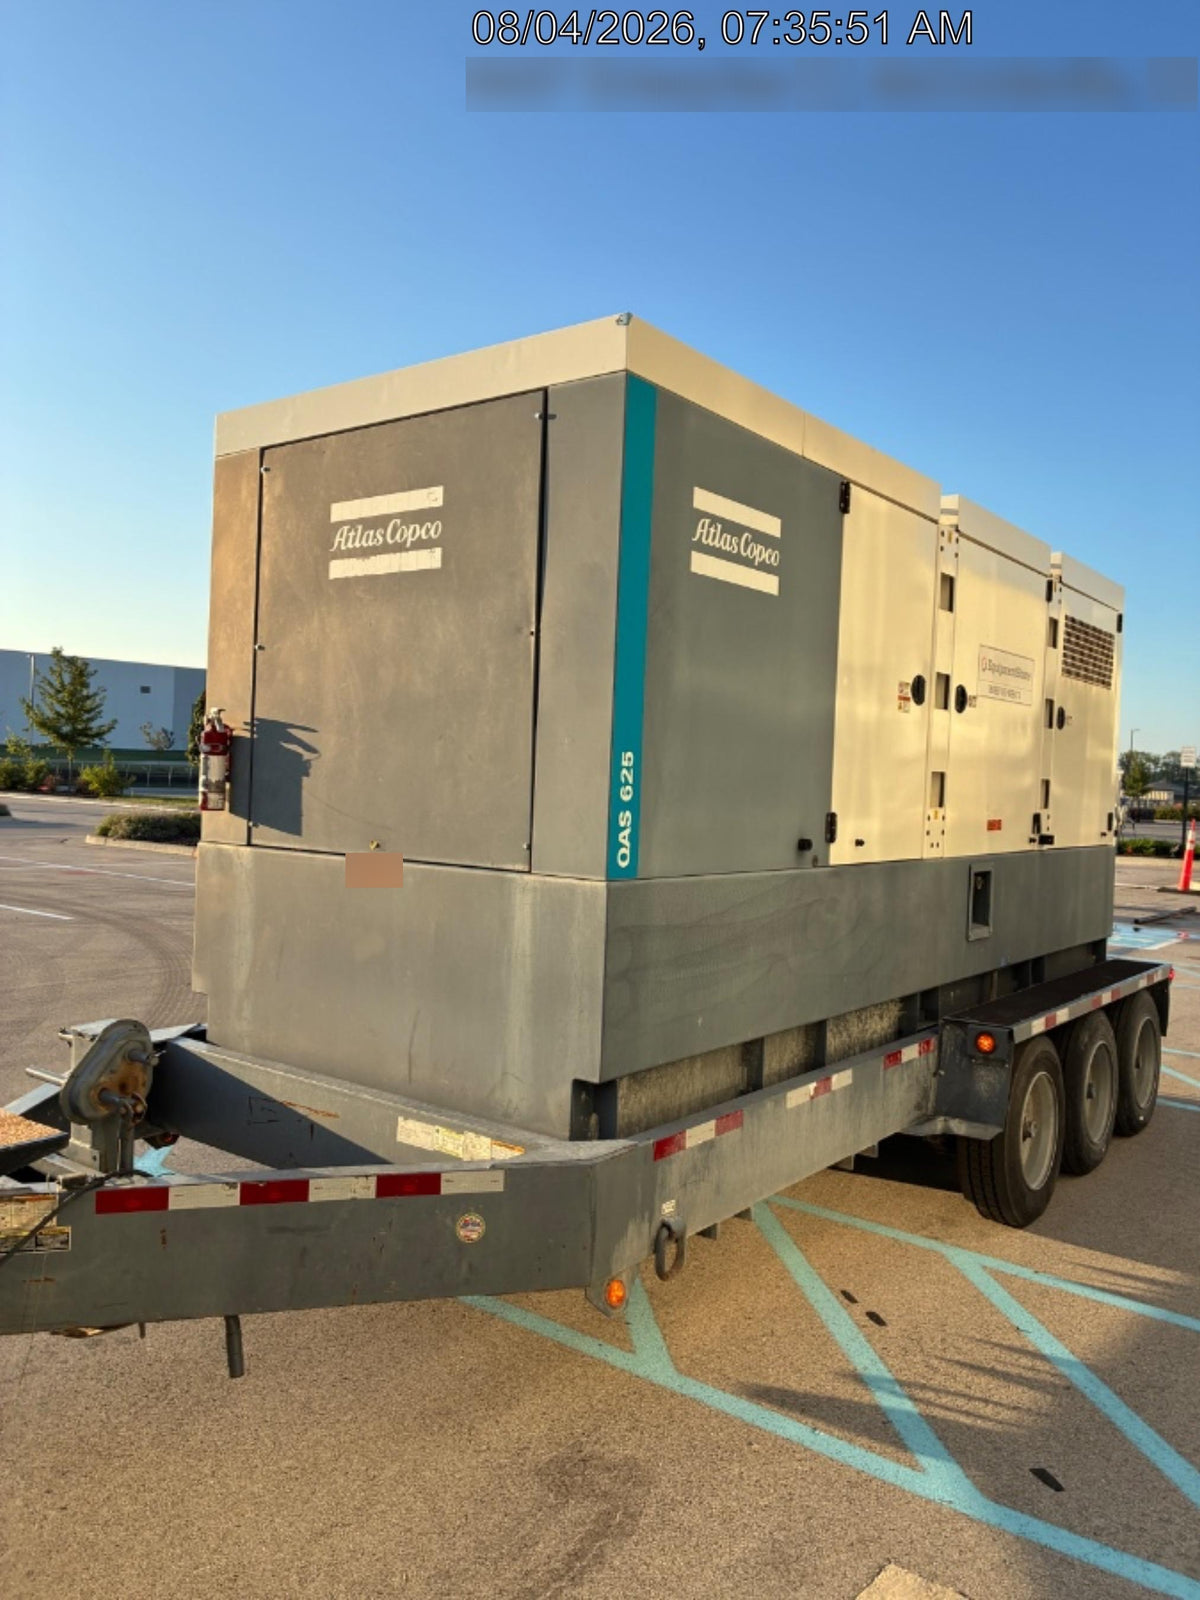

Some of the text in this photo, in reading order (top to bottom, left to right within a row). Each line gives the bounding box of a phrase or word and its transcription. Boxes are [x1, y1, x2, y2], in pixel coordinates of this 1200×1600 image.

[329, 518, 442, 552] Atlas Copco
[691, 518, 780, 566] Atlas Copco
[620, 751, 634, 802] 625
